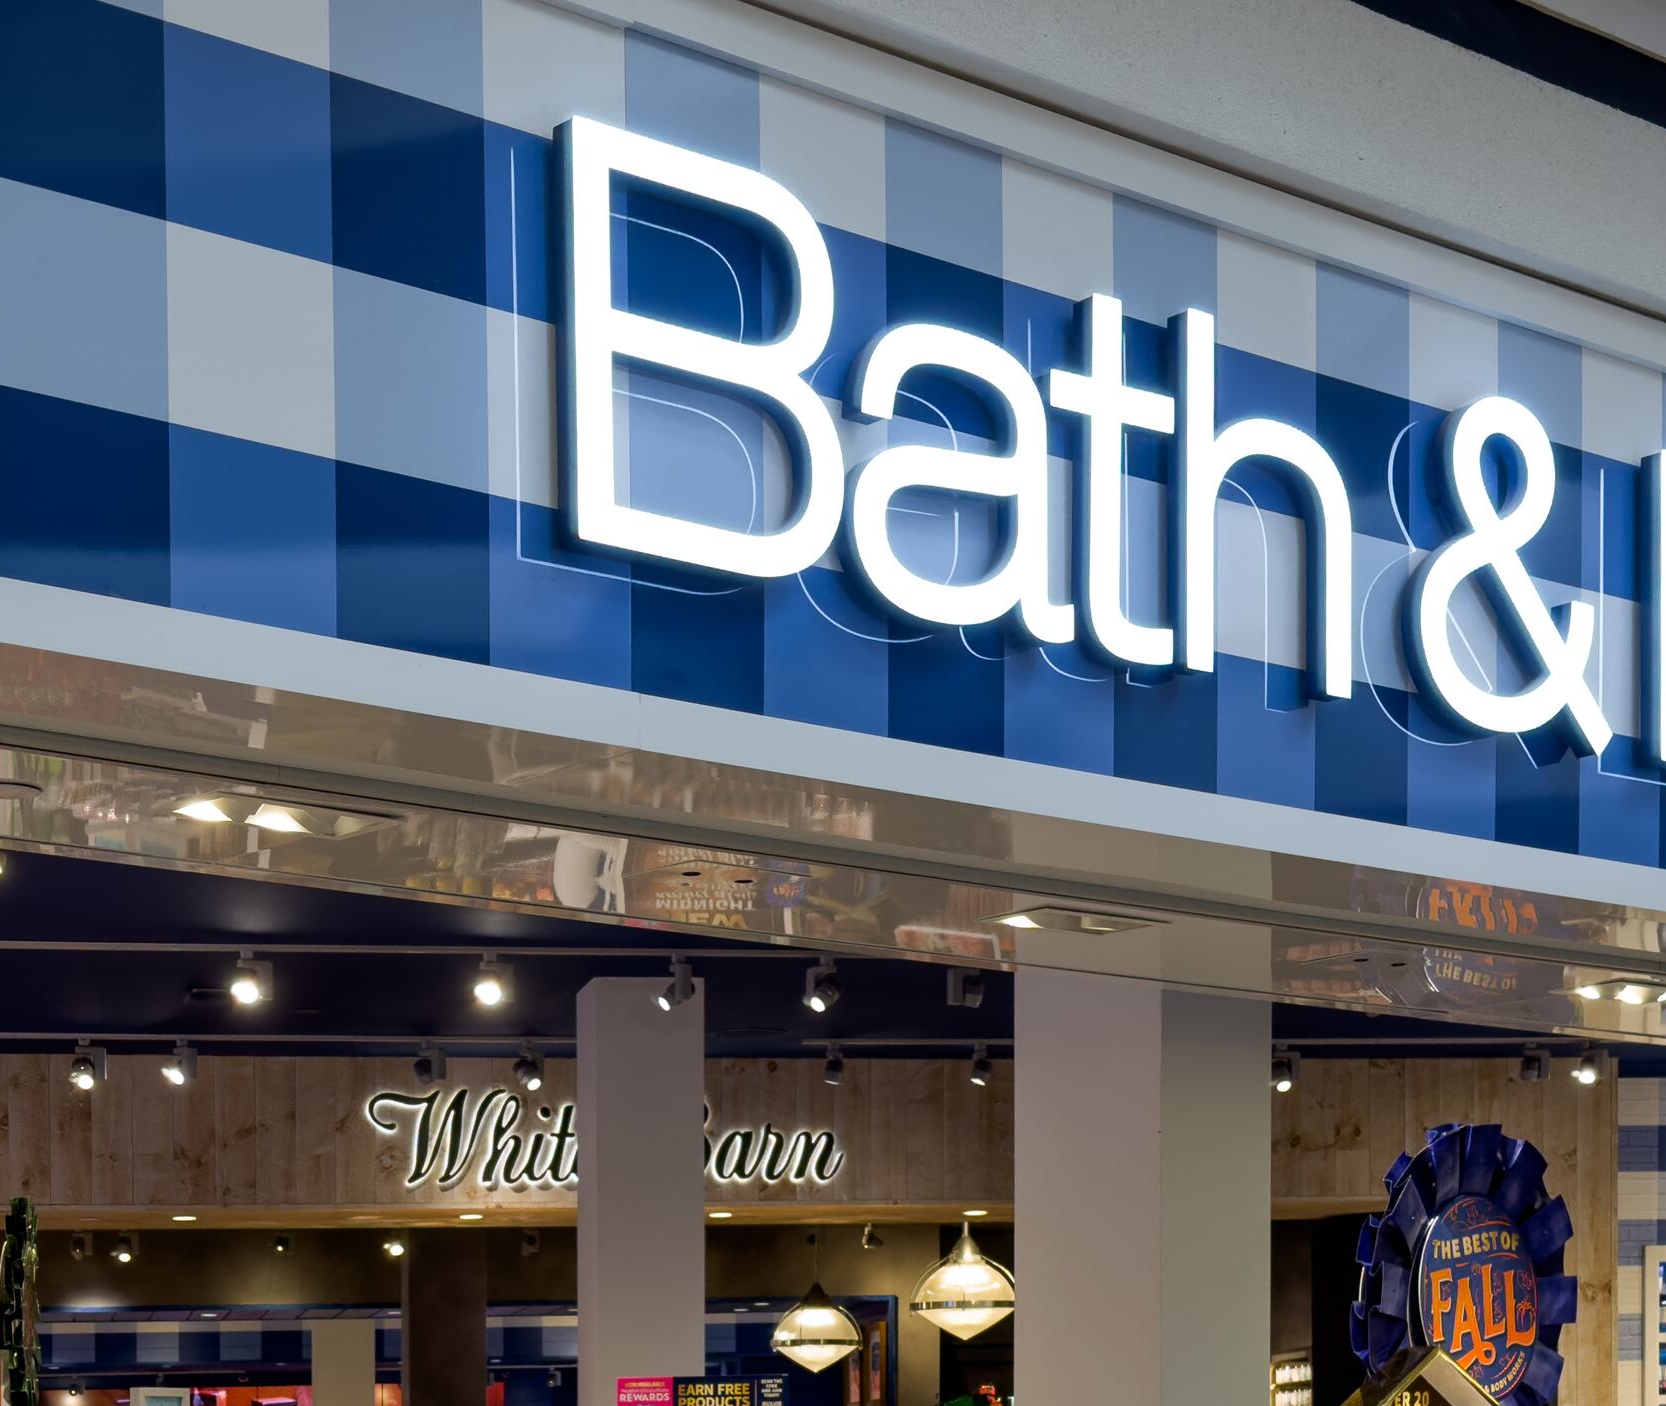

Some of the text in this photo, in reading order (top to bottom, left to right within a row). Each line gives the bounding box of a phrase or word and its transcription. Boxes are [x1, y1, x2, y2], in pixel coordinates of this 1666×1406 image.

[569, 114, 1354, 700] Bath
[1417, 394, 1613, 756] &
[366, 1088, 578, 1186] Whit
[1432, 1231, 1520, 1260] THE BEST OF
[1430, 1264, 1537, 1370] FALL
[677, 1384, 715, 1396] EARN
[717, 1383, 750, 1395] FREE
[1491, 1379, 1508, 1394] BODY
[1507, 1351, 1526, 1382] WORKS
[619, 1393, 670, 1402] REWARDS
